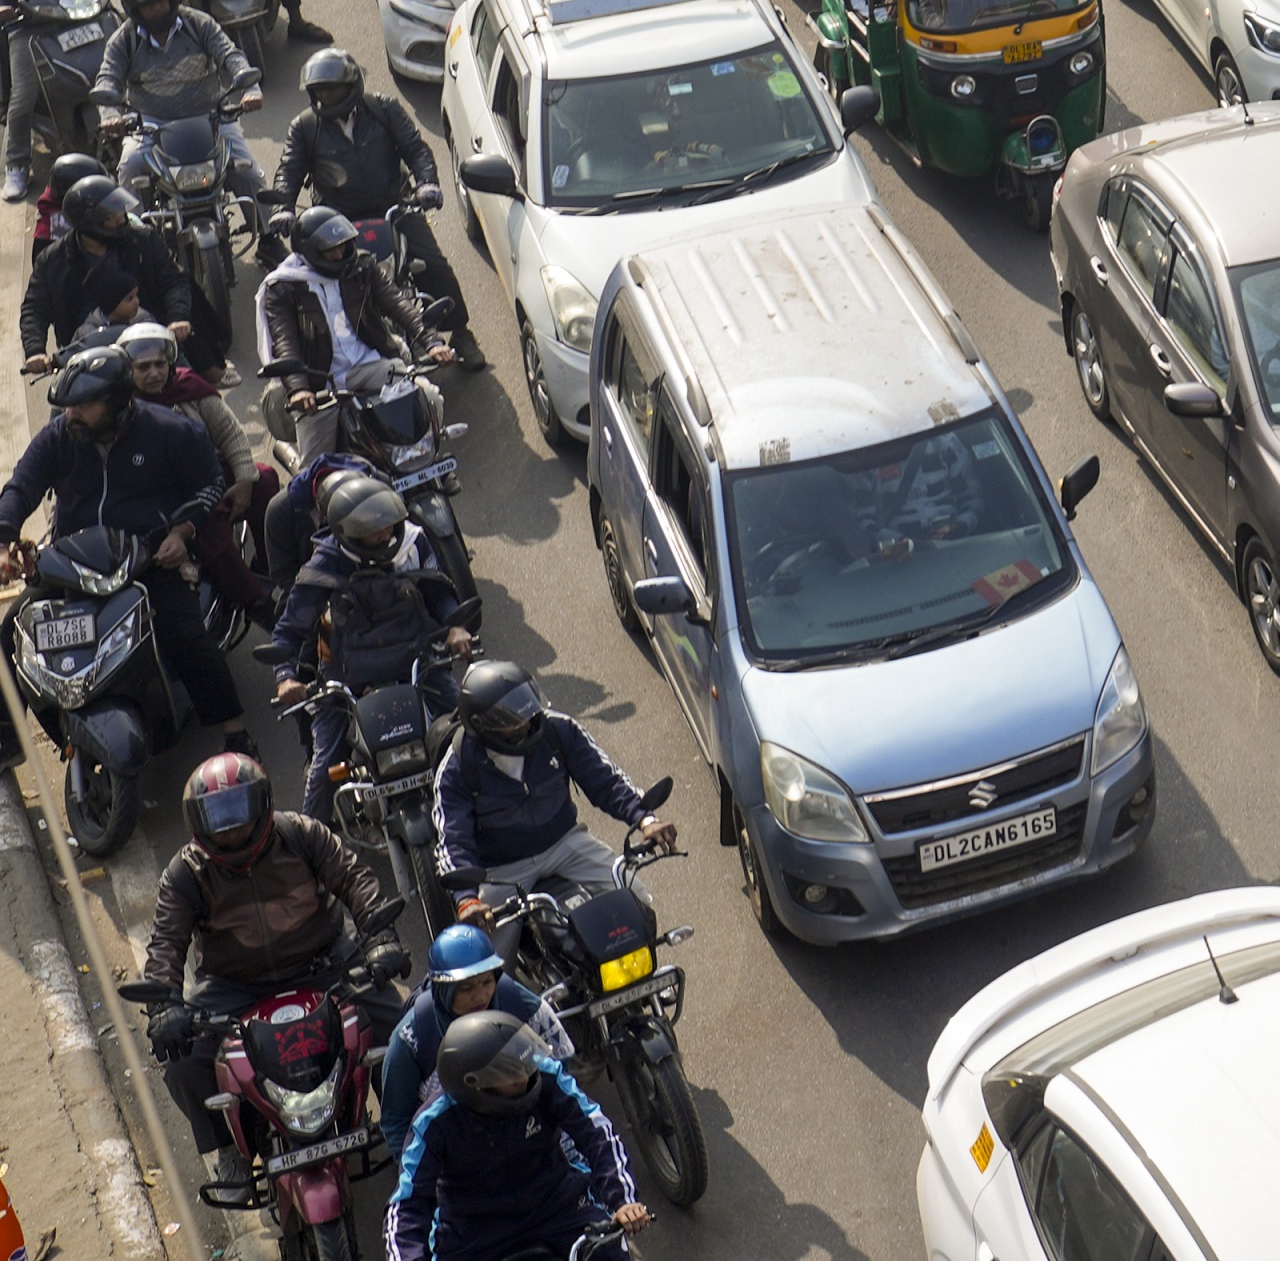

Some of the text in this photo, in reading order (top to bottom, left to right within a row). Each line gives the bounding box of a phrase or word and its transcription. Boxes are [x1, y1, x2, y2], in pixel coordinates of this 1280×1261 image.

[417, 471, 428, 482] ML
[437, 462, 454, 474] 6039
[46, 618, 87, 635] DL7SC
[934, 812, 1055, 863] DL2CAN6165
[281, 1155, 298, 1168] HR
